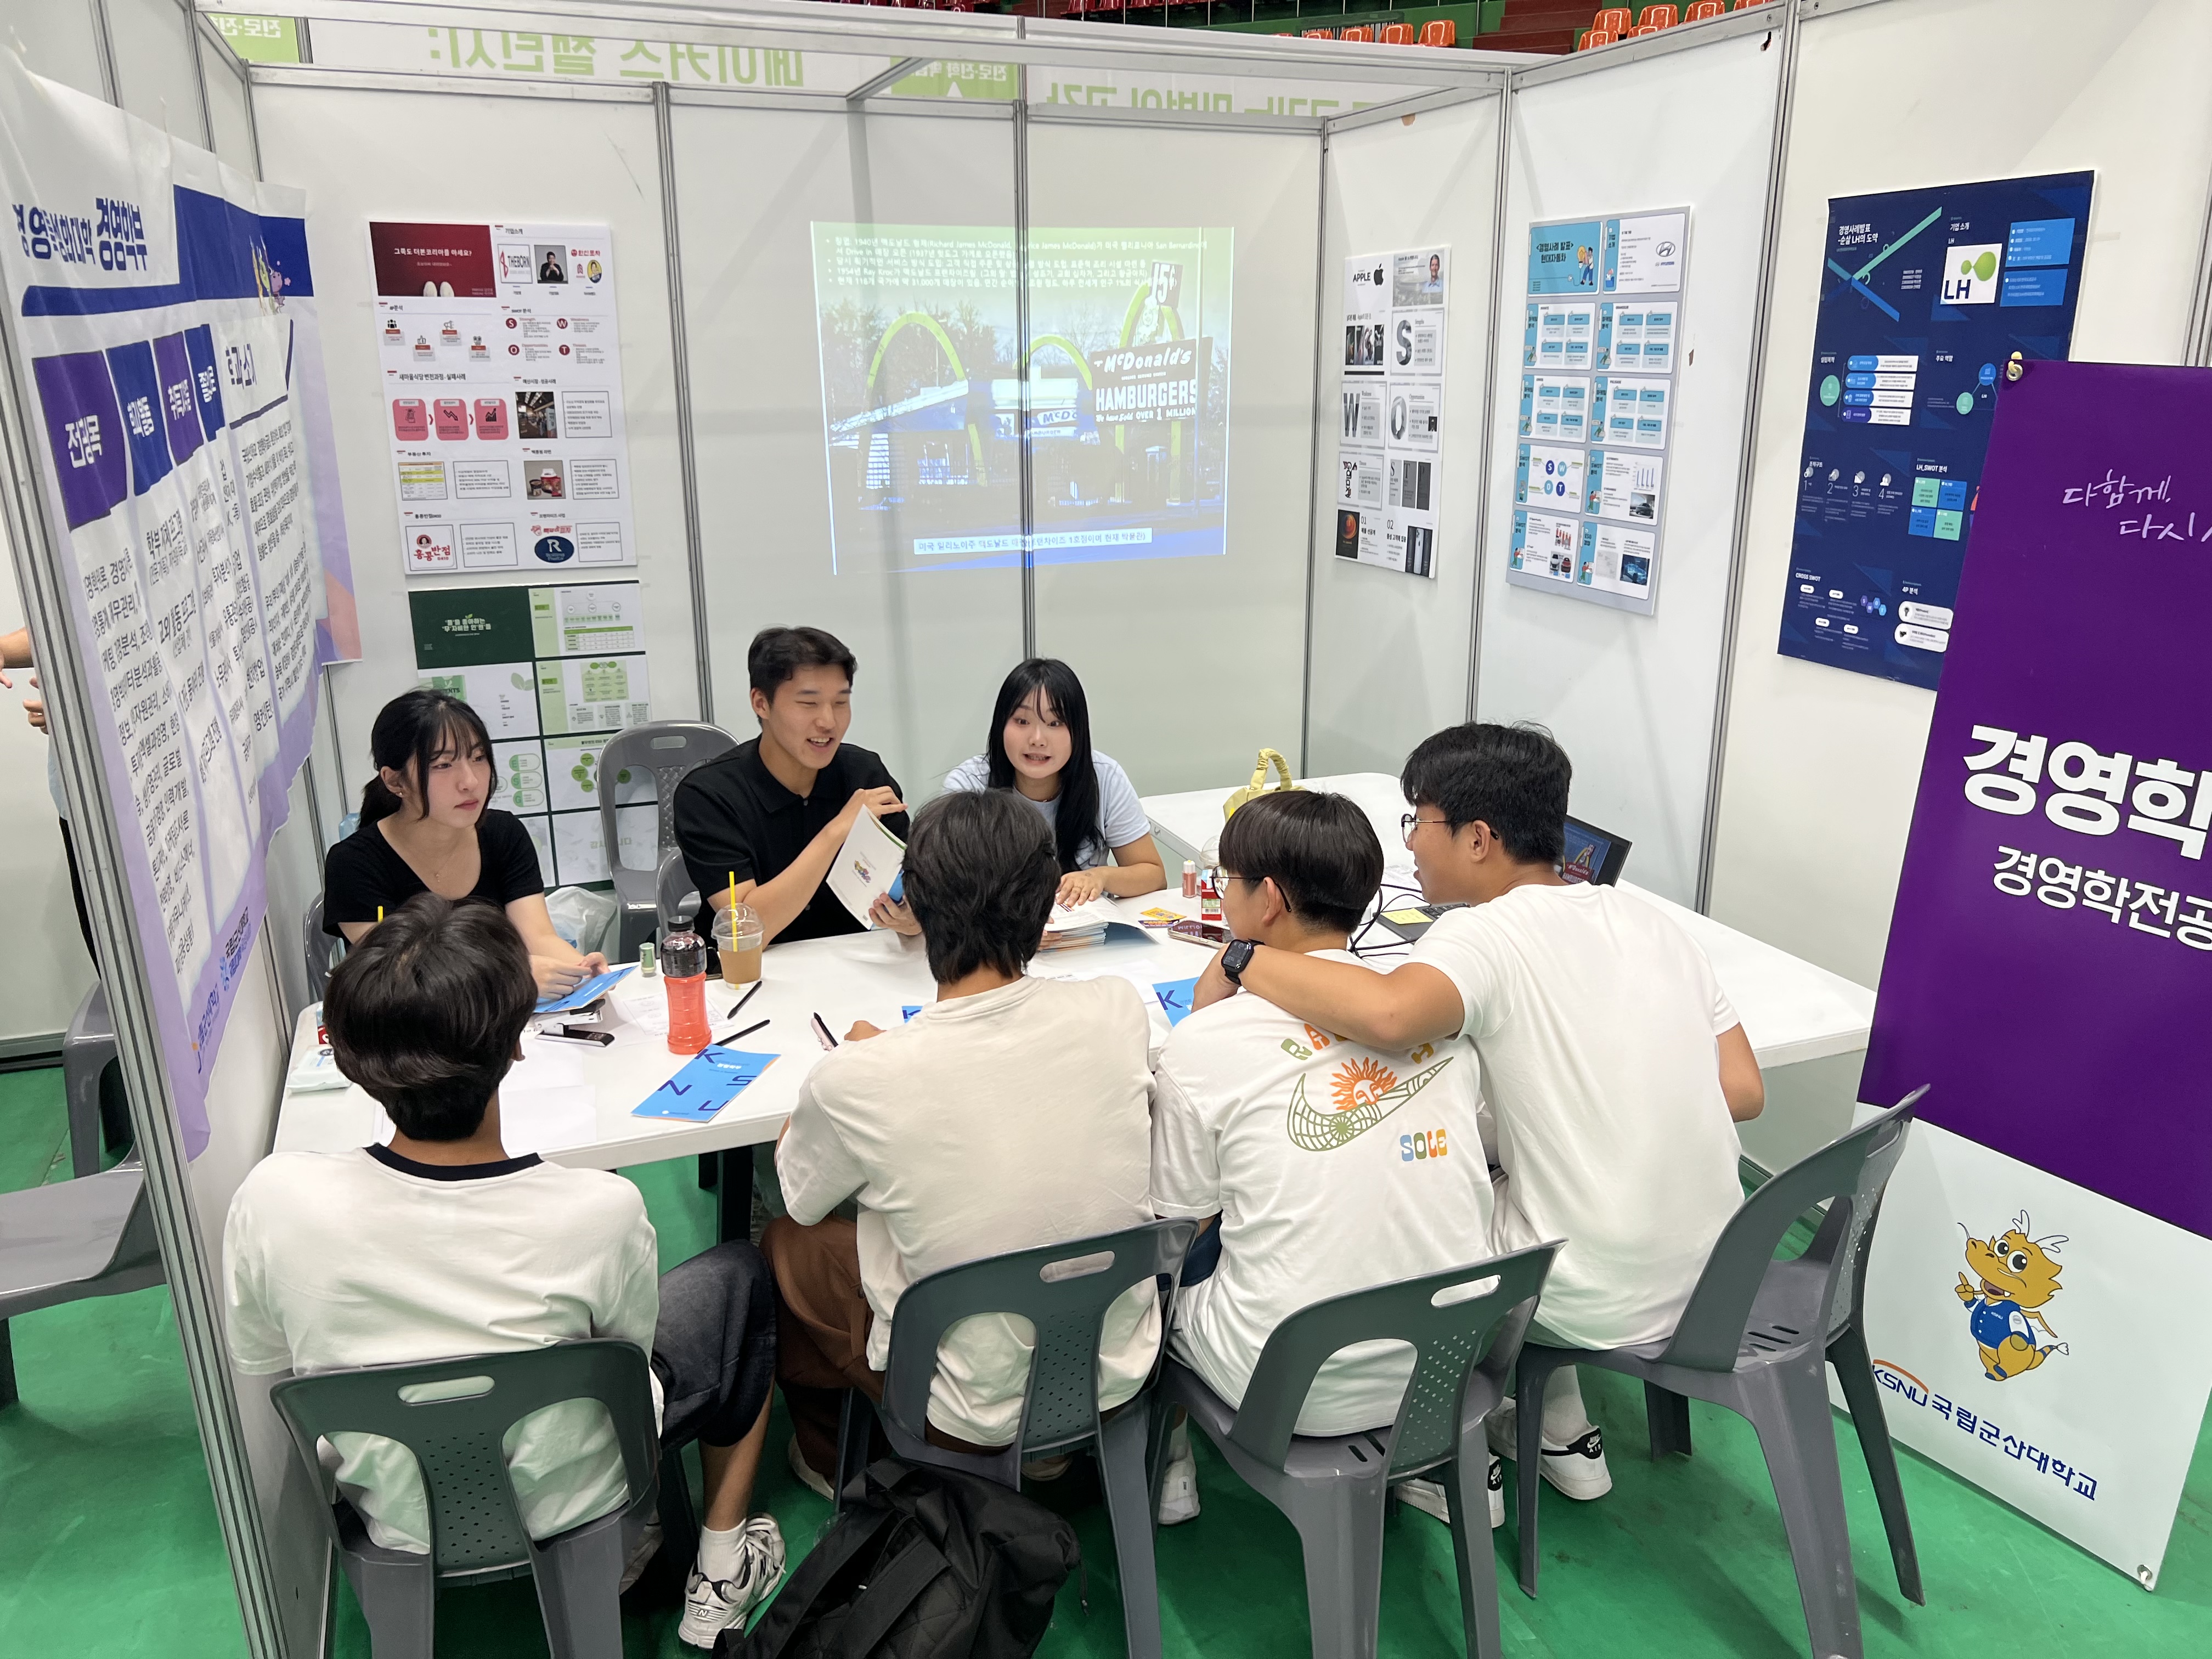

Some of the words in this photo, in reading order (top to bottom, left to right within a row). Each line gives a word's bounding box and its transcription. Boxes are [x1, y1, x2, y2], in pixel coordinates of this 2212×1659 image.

[1839, 223, 1871, 236] 경영사례발표
[1950, 223, 1960, 232] 기업
[1960, 222, 1970, 230] 소개
[96, 198, 147, 271] 경영학부
[1866, 233, 1878, 243] 도약
[978, 241, 1012, 250] McDonald,
[1042, 241, 1060, 250] James
[414, 249, 450, 257] 더본코리아를
[845, 247, 864, 256] Drive
[1541, 253, 1566, 263] 현대자동차
[837, 267, 861, 276] 1954년
[864, 268, 876, 276] Ray
[1353, 272, 1371, 283] APPLE
[1944, 279, 1971, 300] LH
[1396, 320, 1412, 366] S
[1104, 347, 1193, 373] McDonald's
[1136, 409, 1154, 420] OVER
[1343, 393, 1361, 437] W
[1390, 461, 1395, 477] S
[1404, 463, 1410, 479] T
[1548, 463, 1552, 471] S
[1803, 480, 1808, 490] 1
[1827, 483, 1833, 494] 2
[1852, 485, 1859, 496] 3
[2063, 469, 2172, 509] 다함께,
[1878, 488, 1884, 499] 4
[1361, 516, 1367, 525] 01
[1387, 520, 1393, 529] 02
[918, 543, 934, 551] 미국
[1795, 572, 1809, 580] CROSS
[1809, 574, 1821, 582] SWOT
[1156, 990, 1183, 1011] K
[694, 1048, 725, 1064] K
[725, 1075, 757, 1086] S
[658, 1080, 692, 1096] N
[1400, 1128, 1448, 1162] SOLE
[1931, 1393, 2098, 1502] 국립군산대학교
